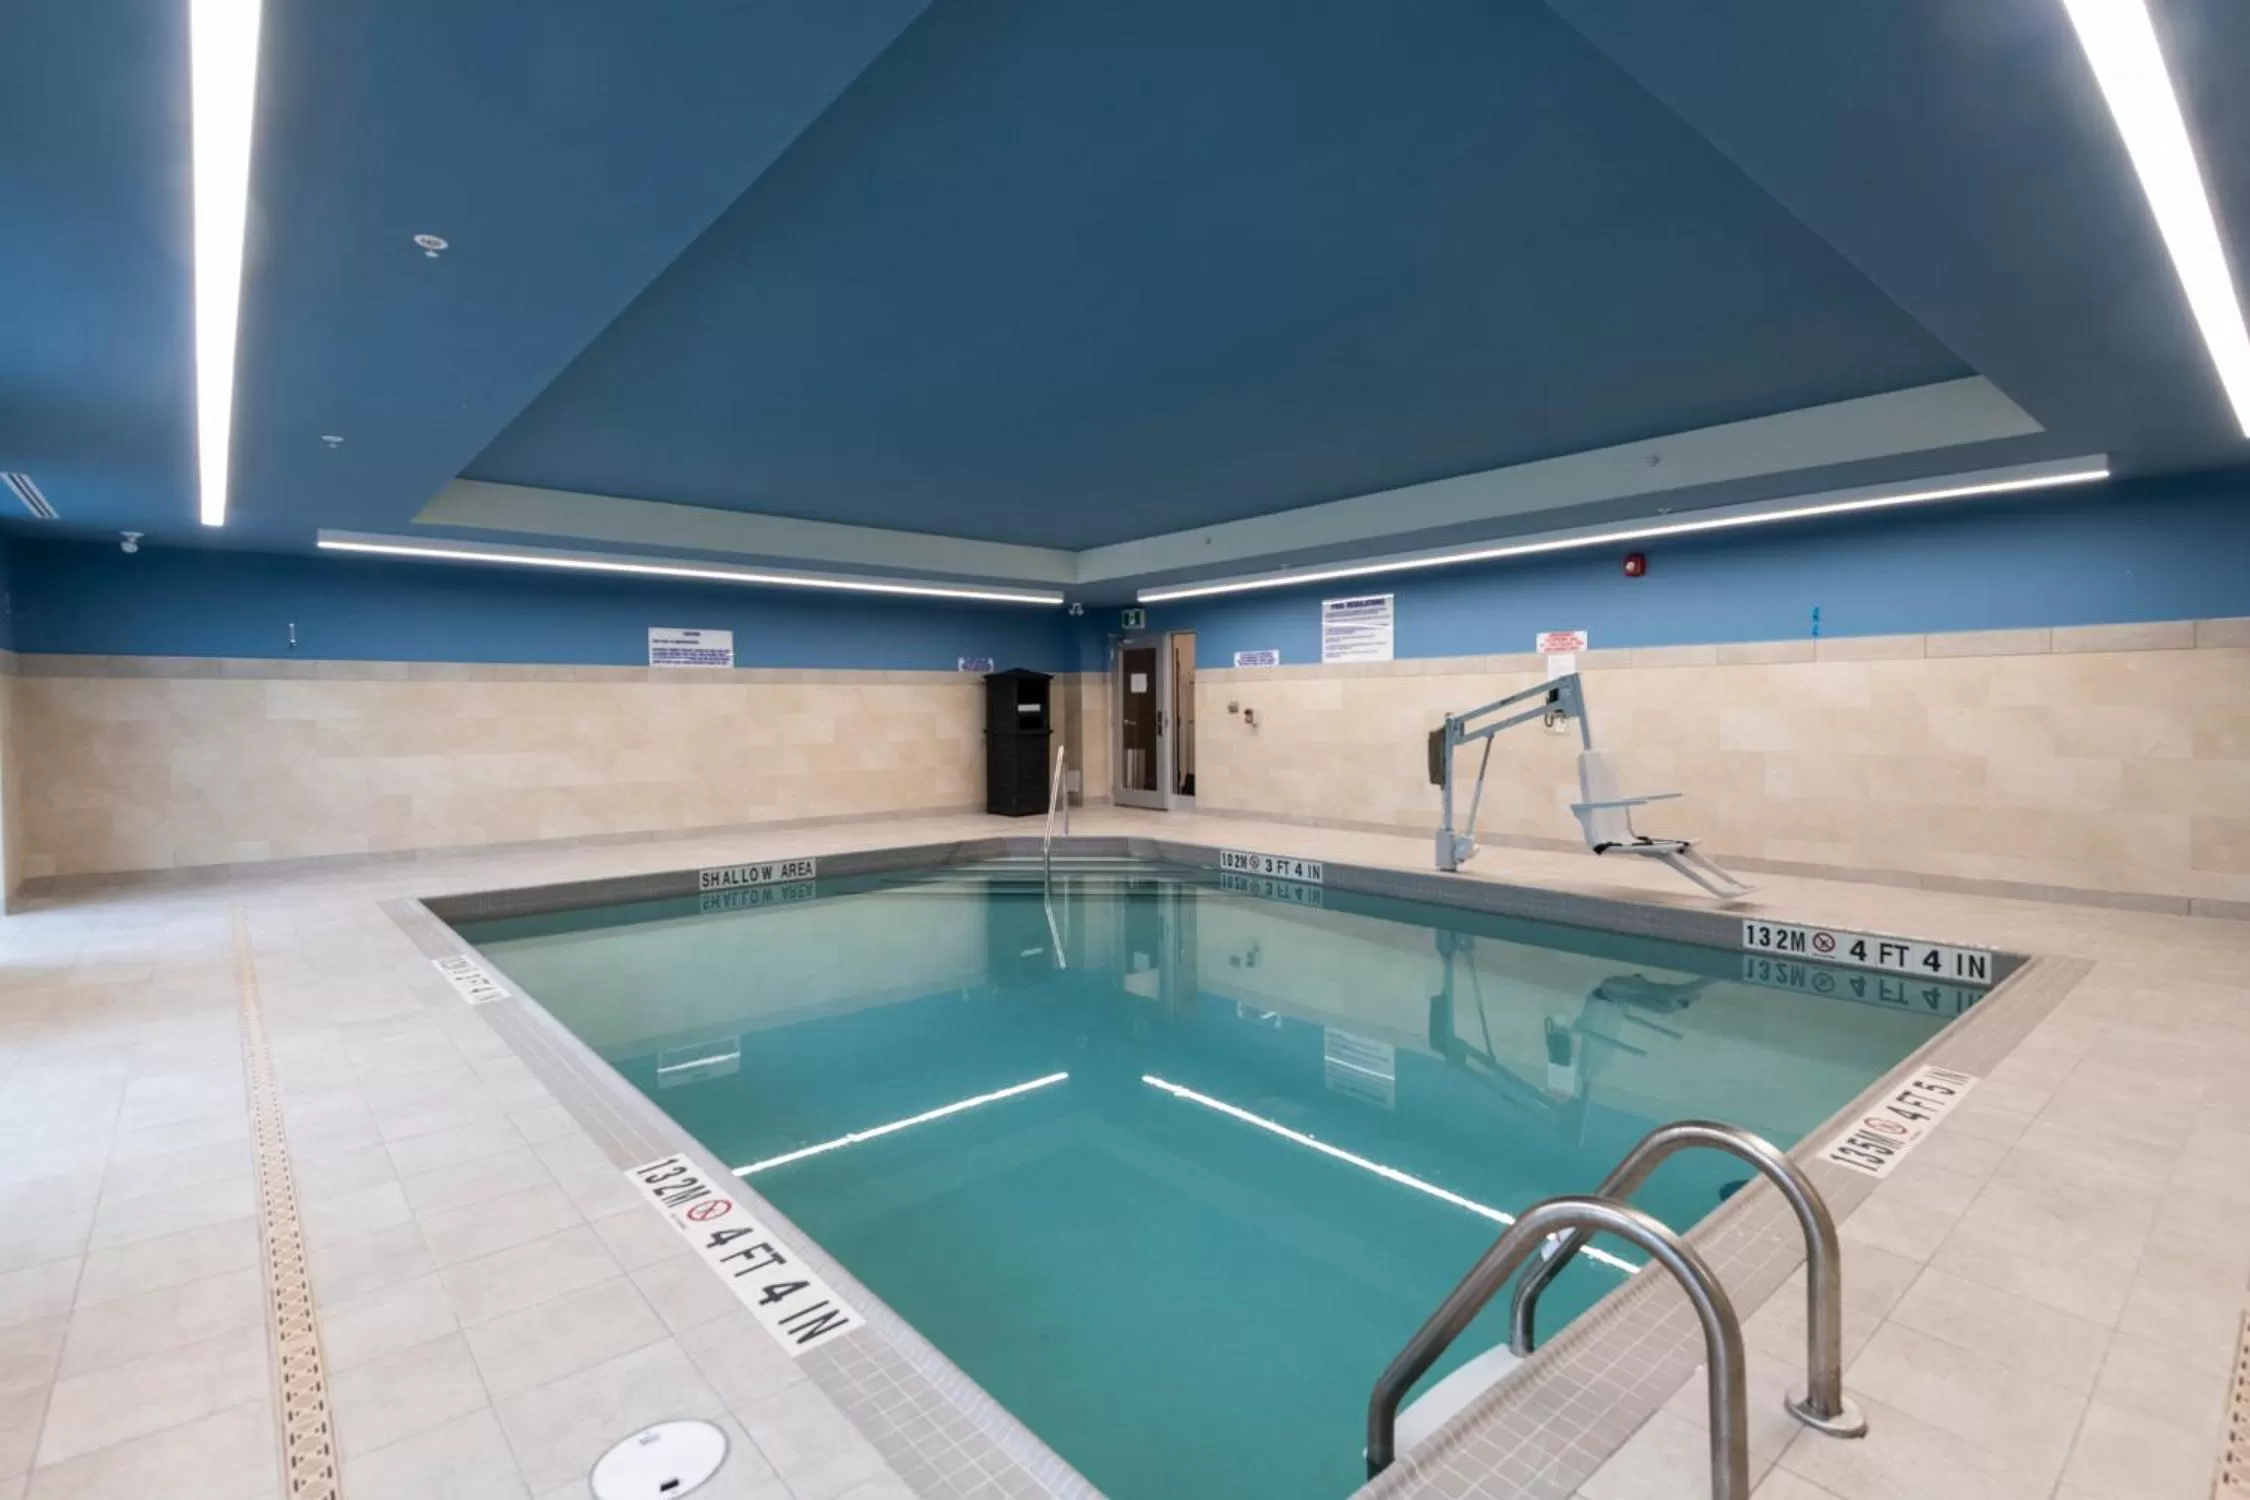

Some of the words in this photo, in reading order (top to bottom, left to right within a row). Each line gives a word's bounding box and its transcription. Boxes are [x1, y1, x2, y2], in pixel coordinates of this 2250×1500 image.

[702, 865, 773, 888] SHALLOW
[781, 861, 813, 878] AREA
[1265, 859, 1273, 873] 3
[1277, 860, 1290, 875] FT
[1295, 863, 1303, 877] 4
[1308, 864, 1320, 879] IN
[1849, 940, 1867, 961] 4
[1880, 942, 1910, 968] FT
[1922, 949, 1942, 972] 4
[1957, 953, 1985, 979] IN
[1912, 1080, 1957, 1096] 5
[1886, 1105, 1931, 1121] 4
[1896, 1090, 1945, 1112] FT
[706, 1227, 754, 1249] 4
[719, 1242, 787, 1278] FT
[758, 1280, 810, 1306] 4
[778, 1299, 850, 1345] IN
